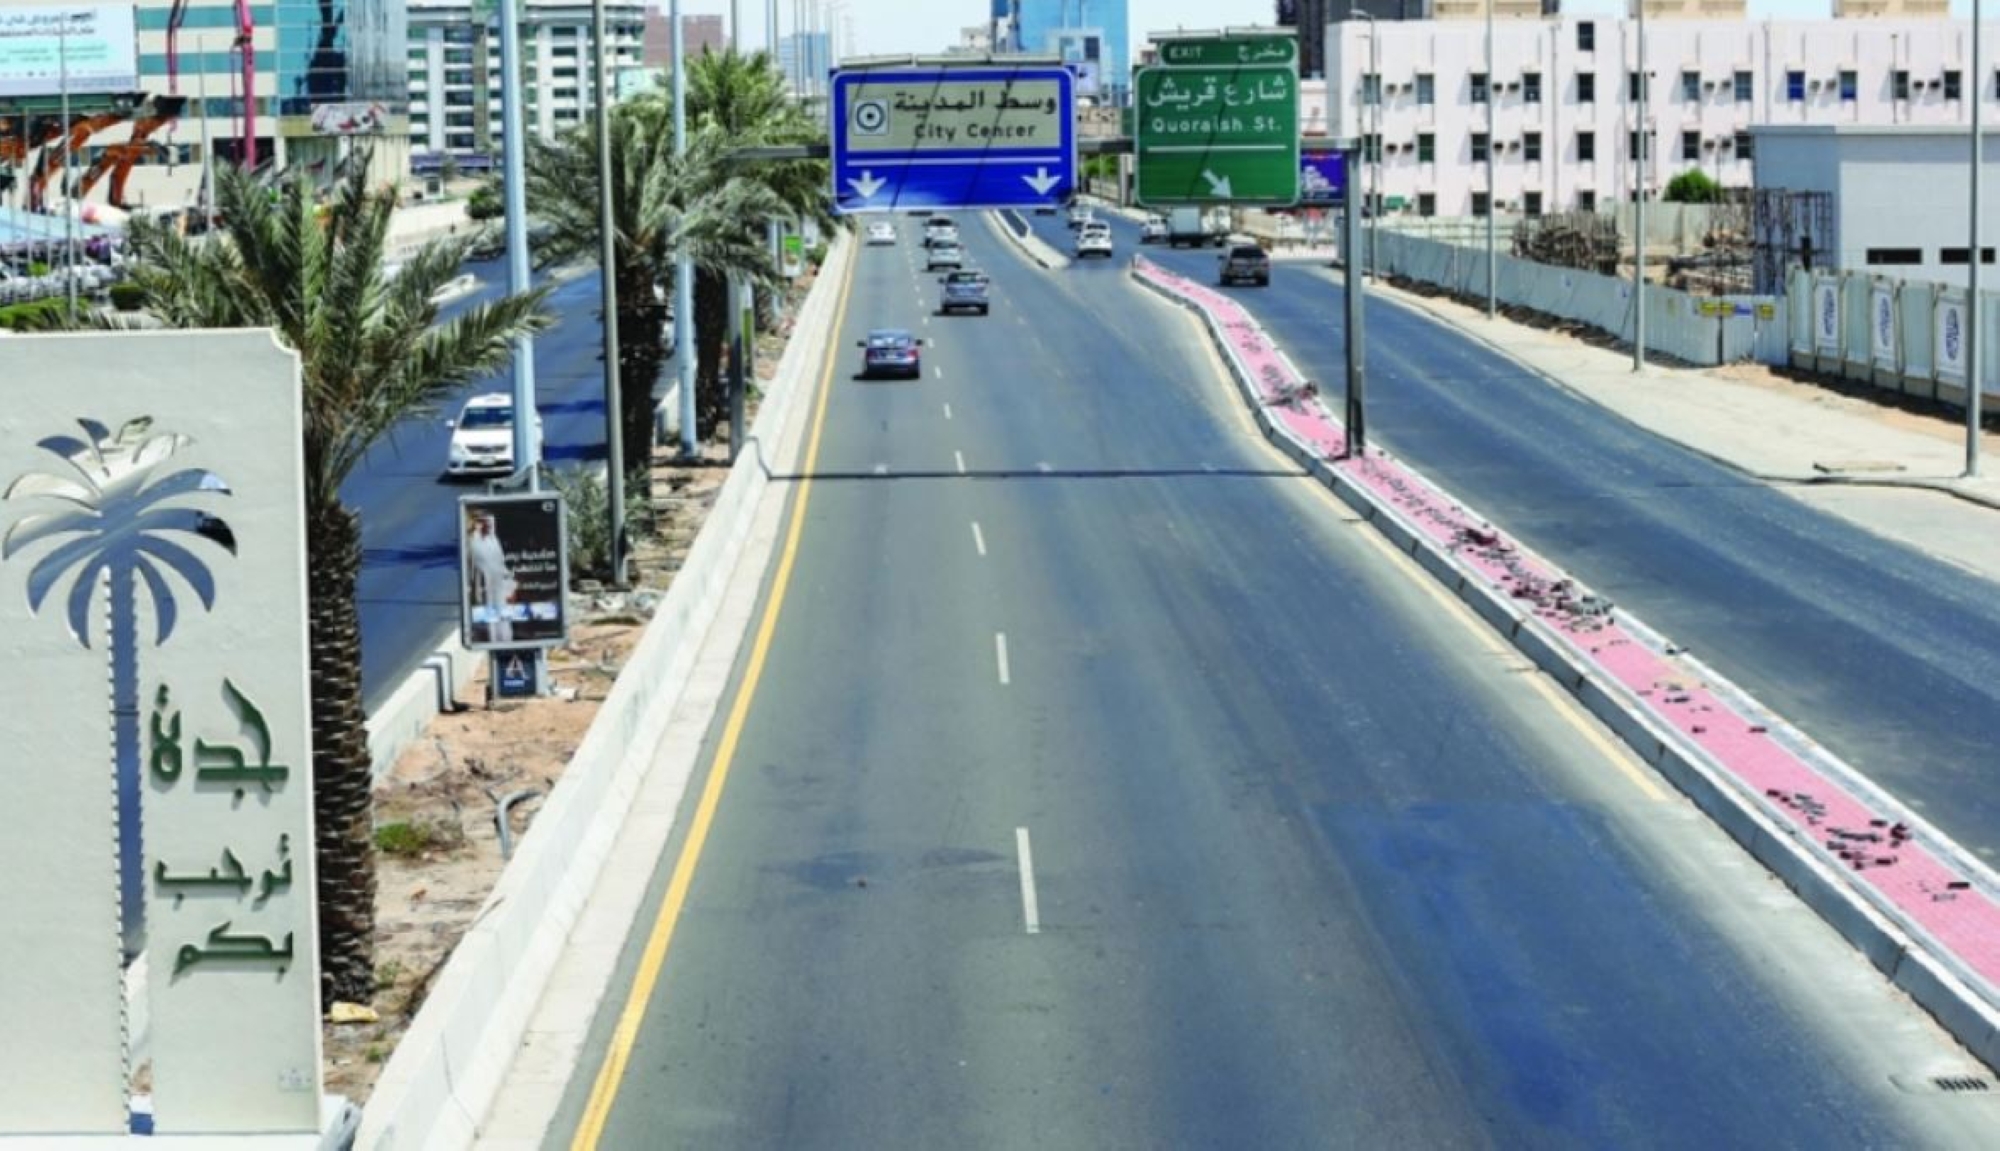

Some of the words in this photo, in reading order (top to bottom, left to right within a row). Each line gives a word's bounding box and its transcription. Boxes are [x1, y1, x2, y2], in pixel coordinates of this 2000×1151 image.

[1168, 46, 1203, 59] EXIT
[1237, 43, 1287, 61] مخرج
[893, 90, 985, 119] المدينة
[995, 88, 1057, 115] وسط
[1146, 75, 1218, 112] قريش
[1223, 74, 1287, 106] شارع
[914, 123, 957, 142] City
[1253, 115, 1283, 133] St.
[150, 677, 290, 802] جدة
[154, 832, 293, 905] ترحب
[170, 919, 294, 981] بكم
